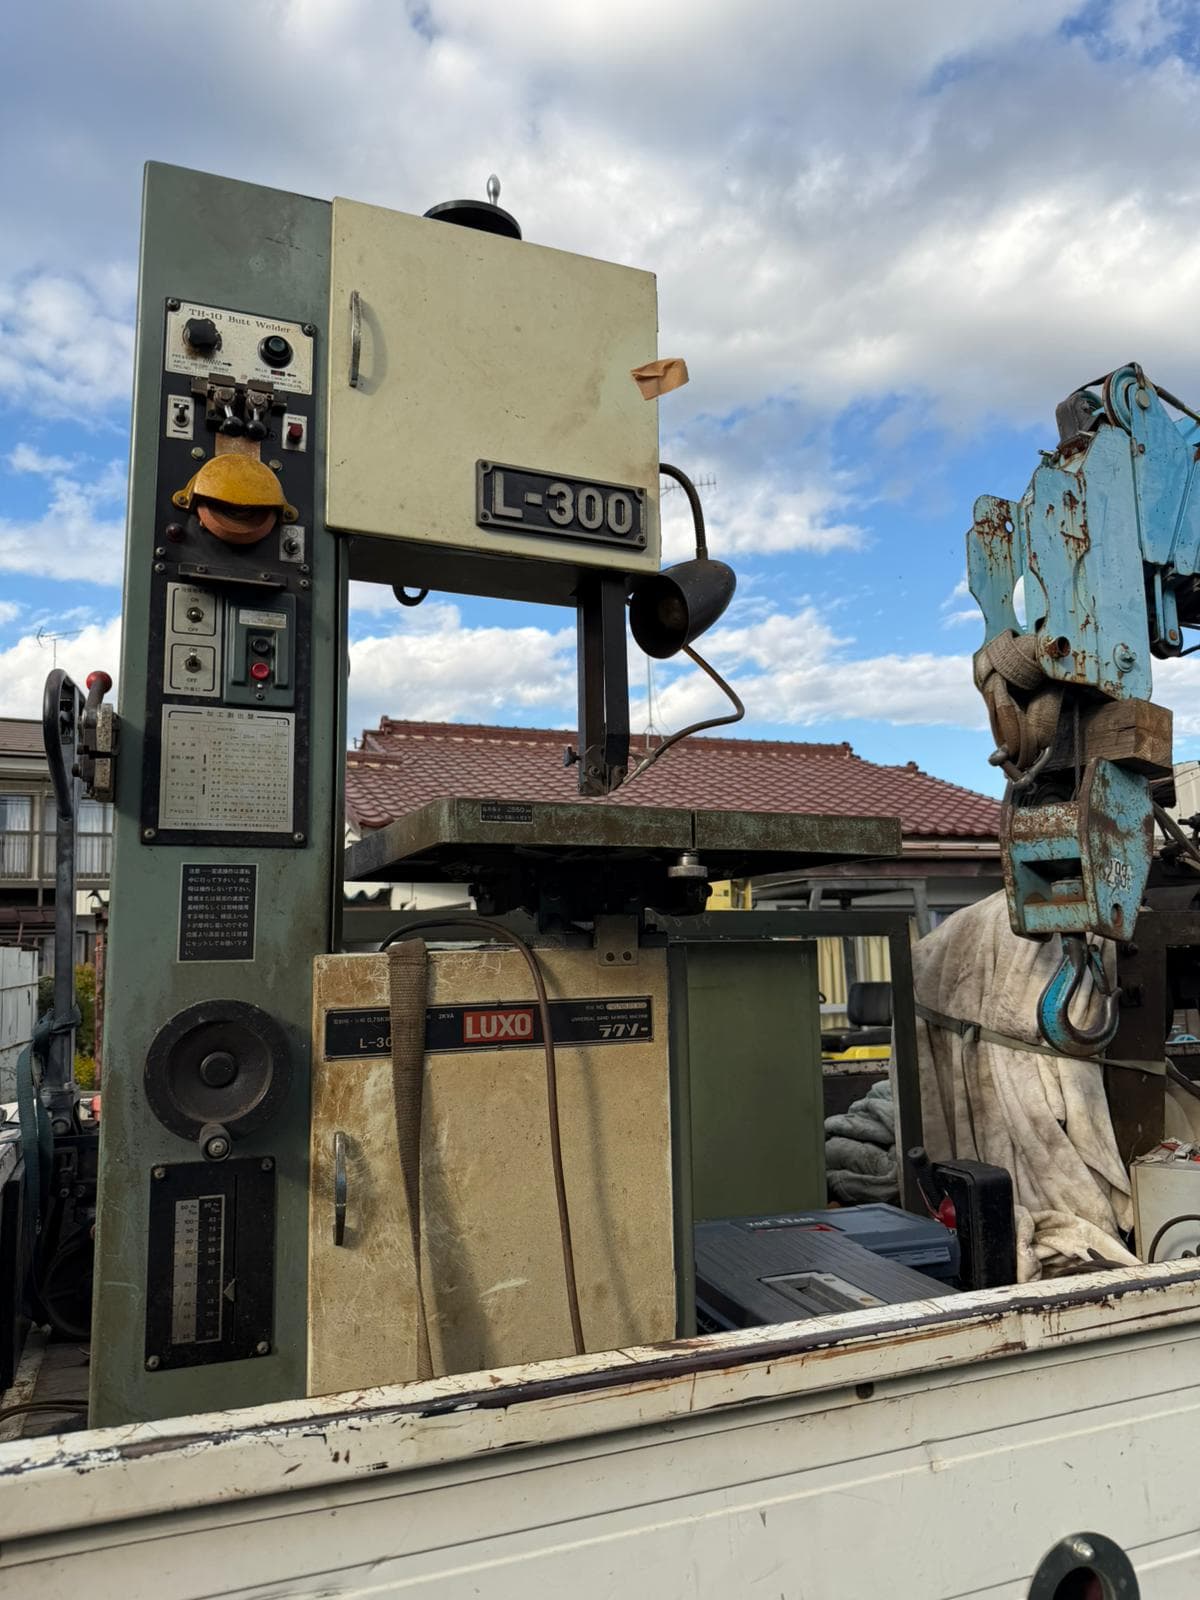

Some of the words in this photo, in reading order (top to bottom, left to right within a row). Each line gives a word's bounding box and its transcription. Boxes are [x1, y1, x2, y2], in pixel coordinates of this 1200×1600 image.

[228, 316, 250, 326] Butt
[256, 320, 291, 334] Welder
[492, 471, 633, 535] L-300
[466, 1014, 532, 1038] LUXO
[360, 1037, 392, 1049] L-30
